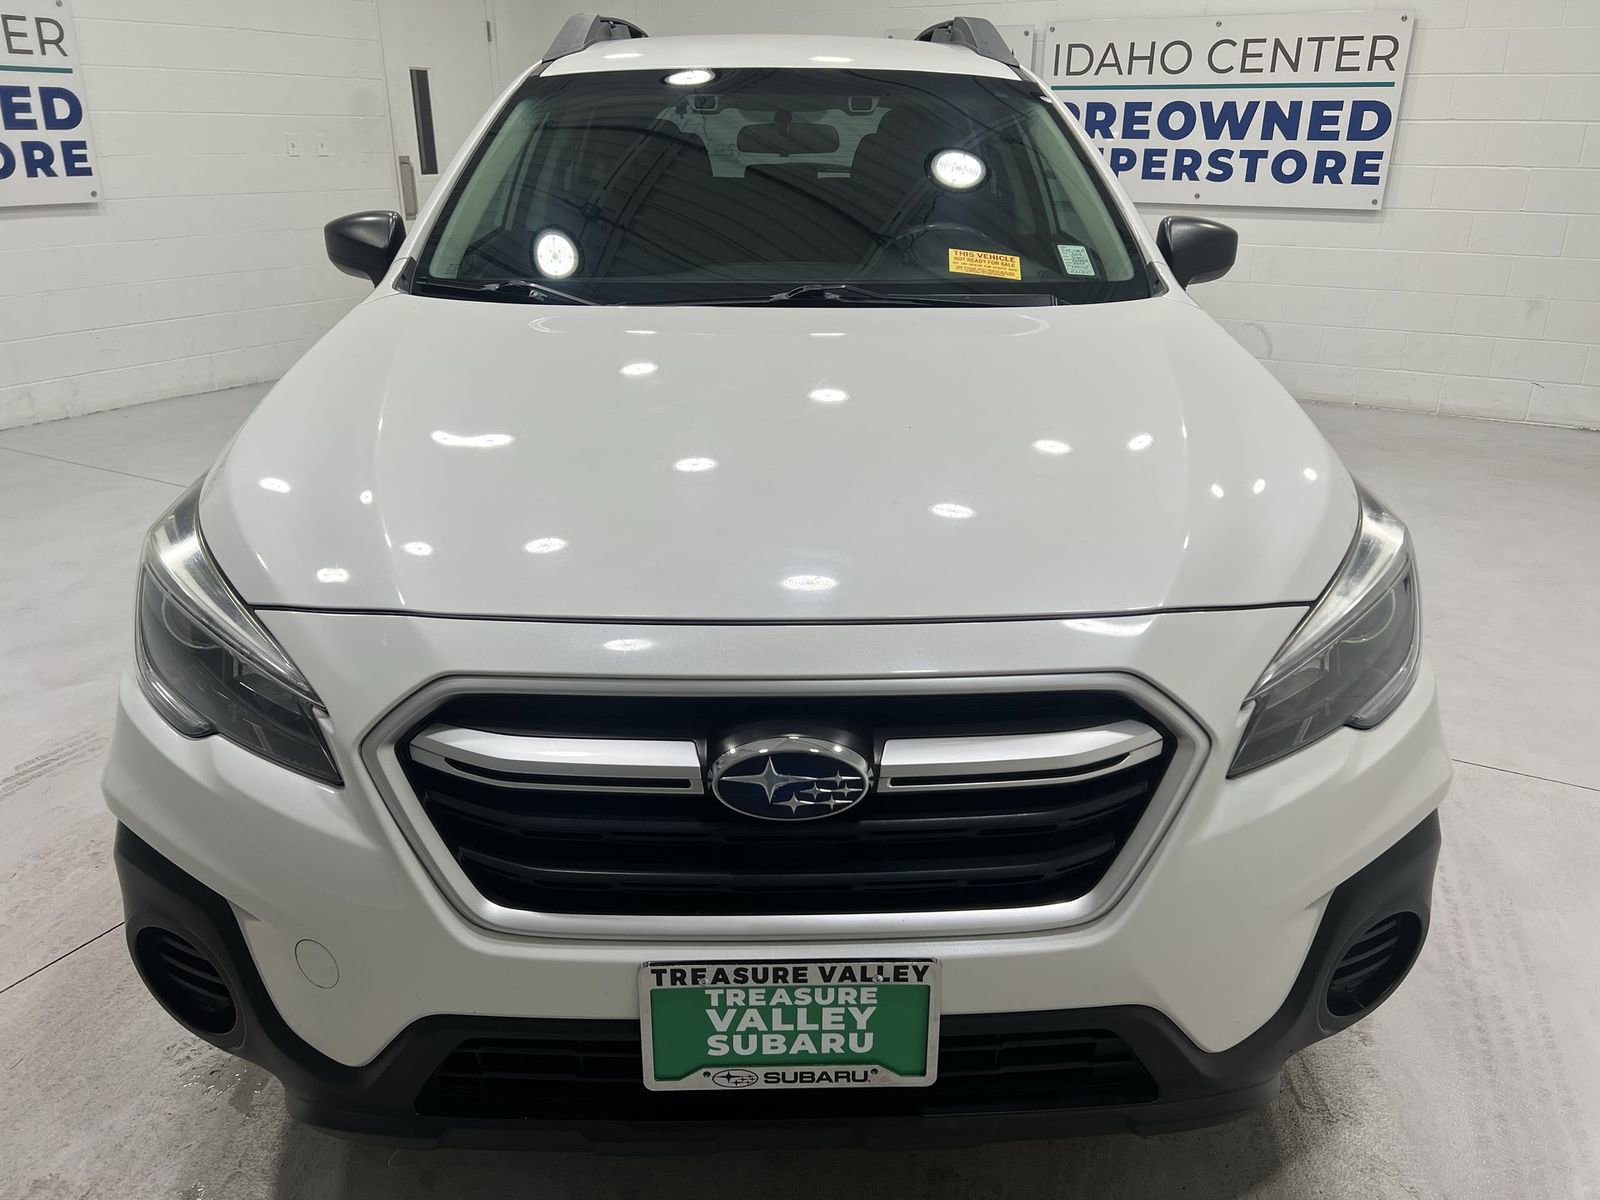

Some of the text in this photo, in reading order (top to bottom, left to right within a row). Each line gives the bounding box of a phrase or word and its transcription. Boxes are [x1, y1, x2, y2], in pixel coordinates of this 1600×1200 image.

[1053, 35, 1400, 77] IDAHO CENTER
[1098, 147, 1385, 185] PERSTORE
[954, 250, 1016, 263] THIS VEHICLE
[651, 965, 930, 987] TREASURE VALLEY
[705, 987, 878, 1007] TREASURE
[705, 1006, 878, 1032] VALLEY
[707, 1032, 874, 1056] SUBARU
[763, 1070, 869, 1084] SUBARU
